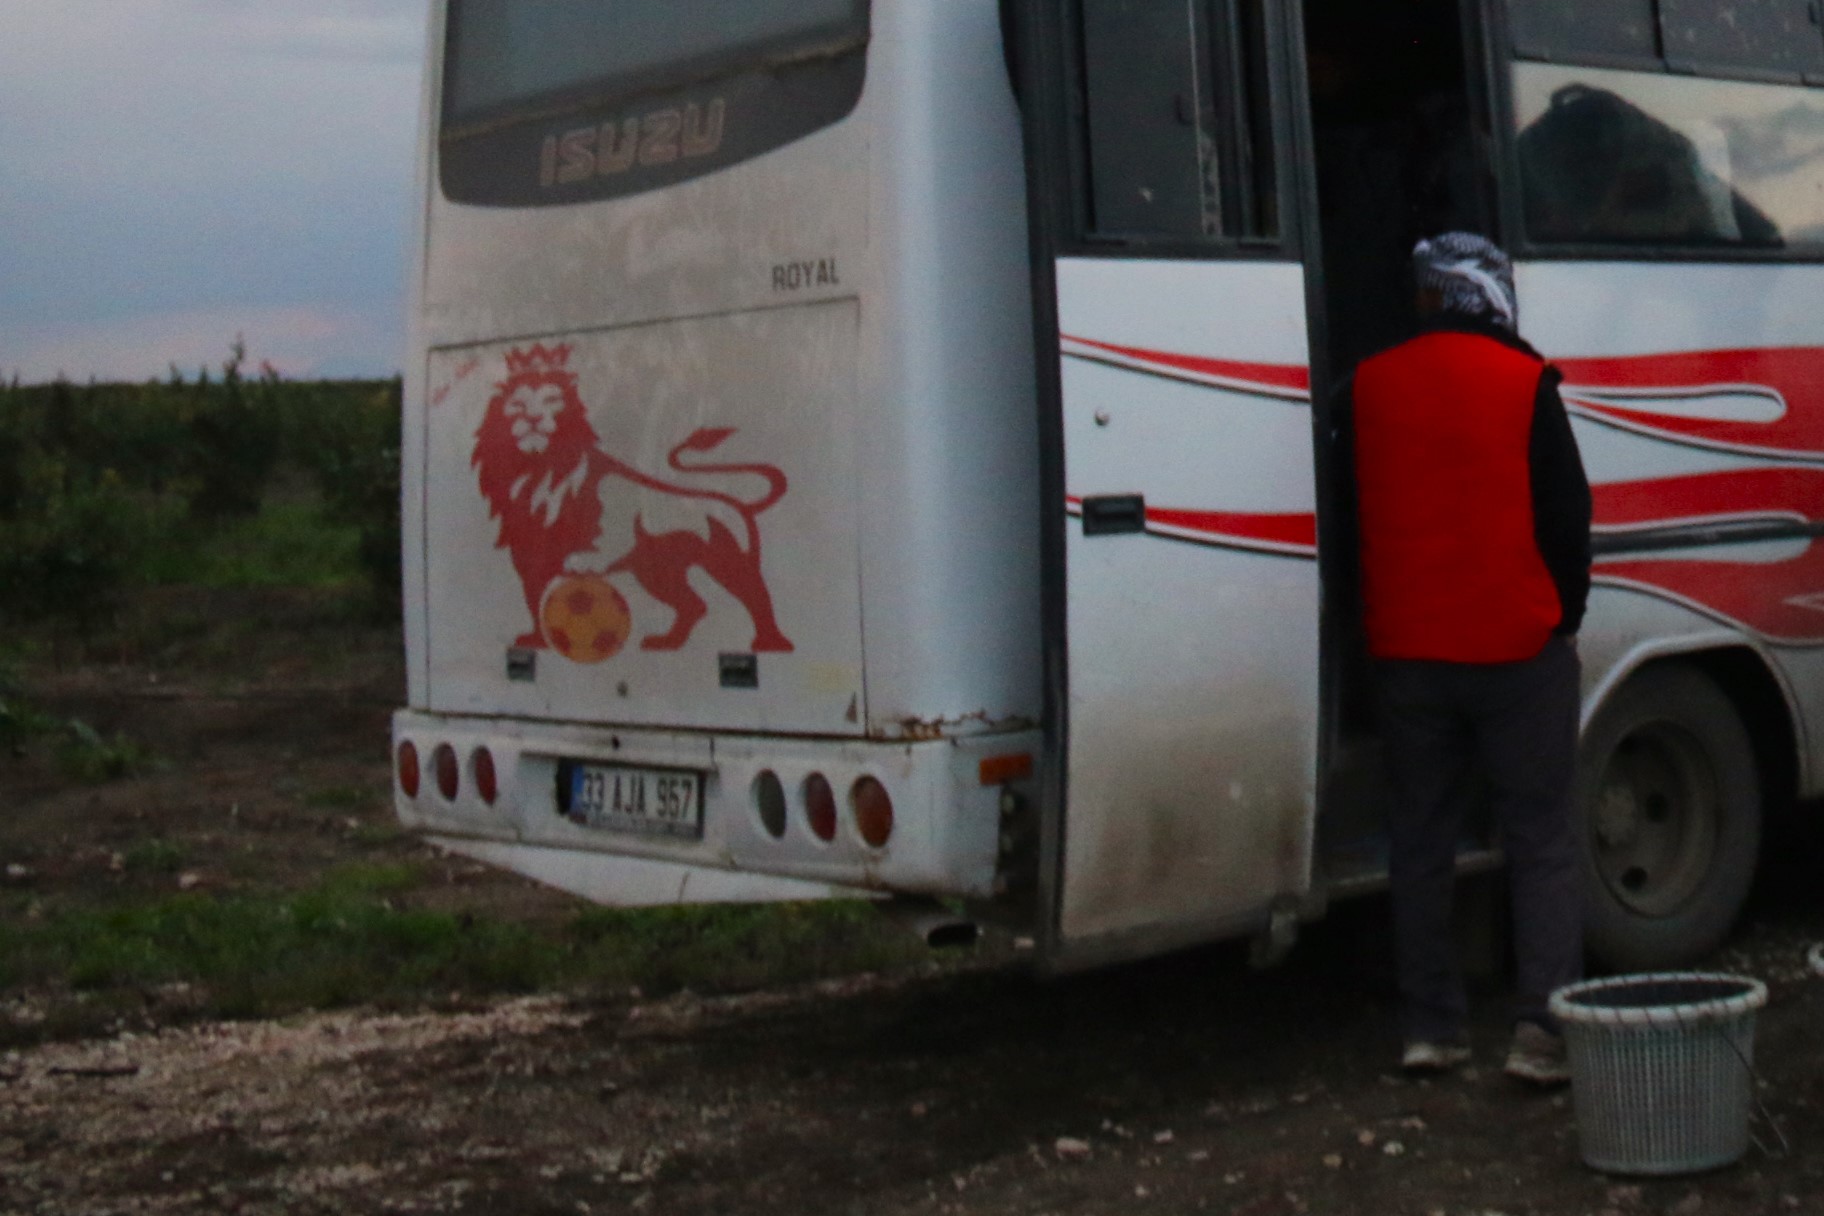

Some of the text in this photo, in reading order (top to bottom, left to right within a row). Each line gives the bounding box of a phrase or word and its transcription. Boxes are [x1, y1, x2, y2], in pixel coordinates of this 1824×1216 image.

[539, 97, 727, 188] ISUZU
[771, 257, 840, 291] ROYAL
[582, 771, 605, 810] 33
